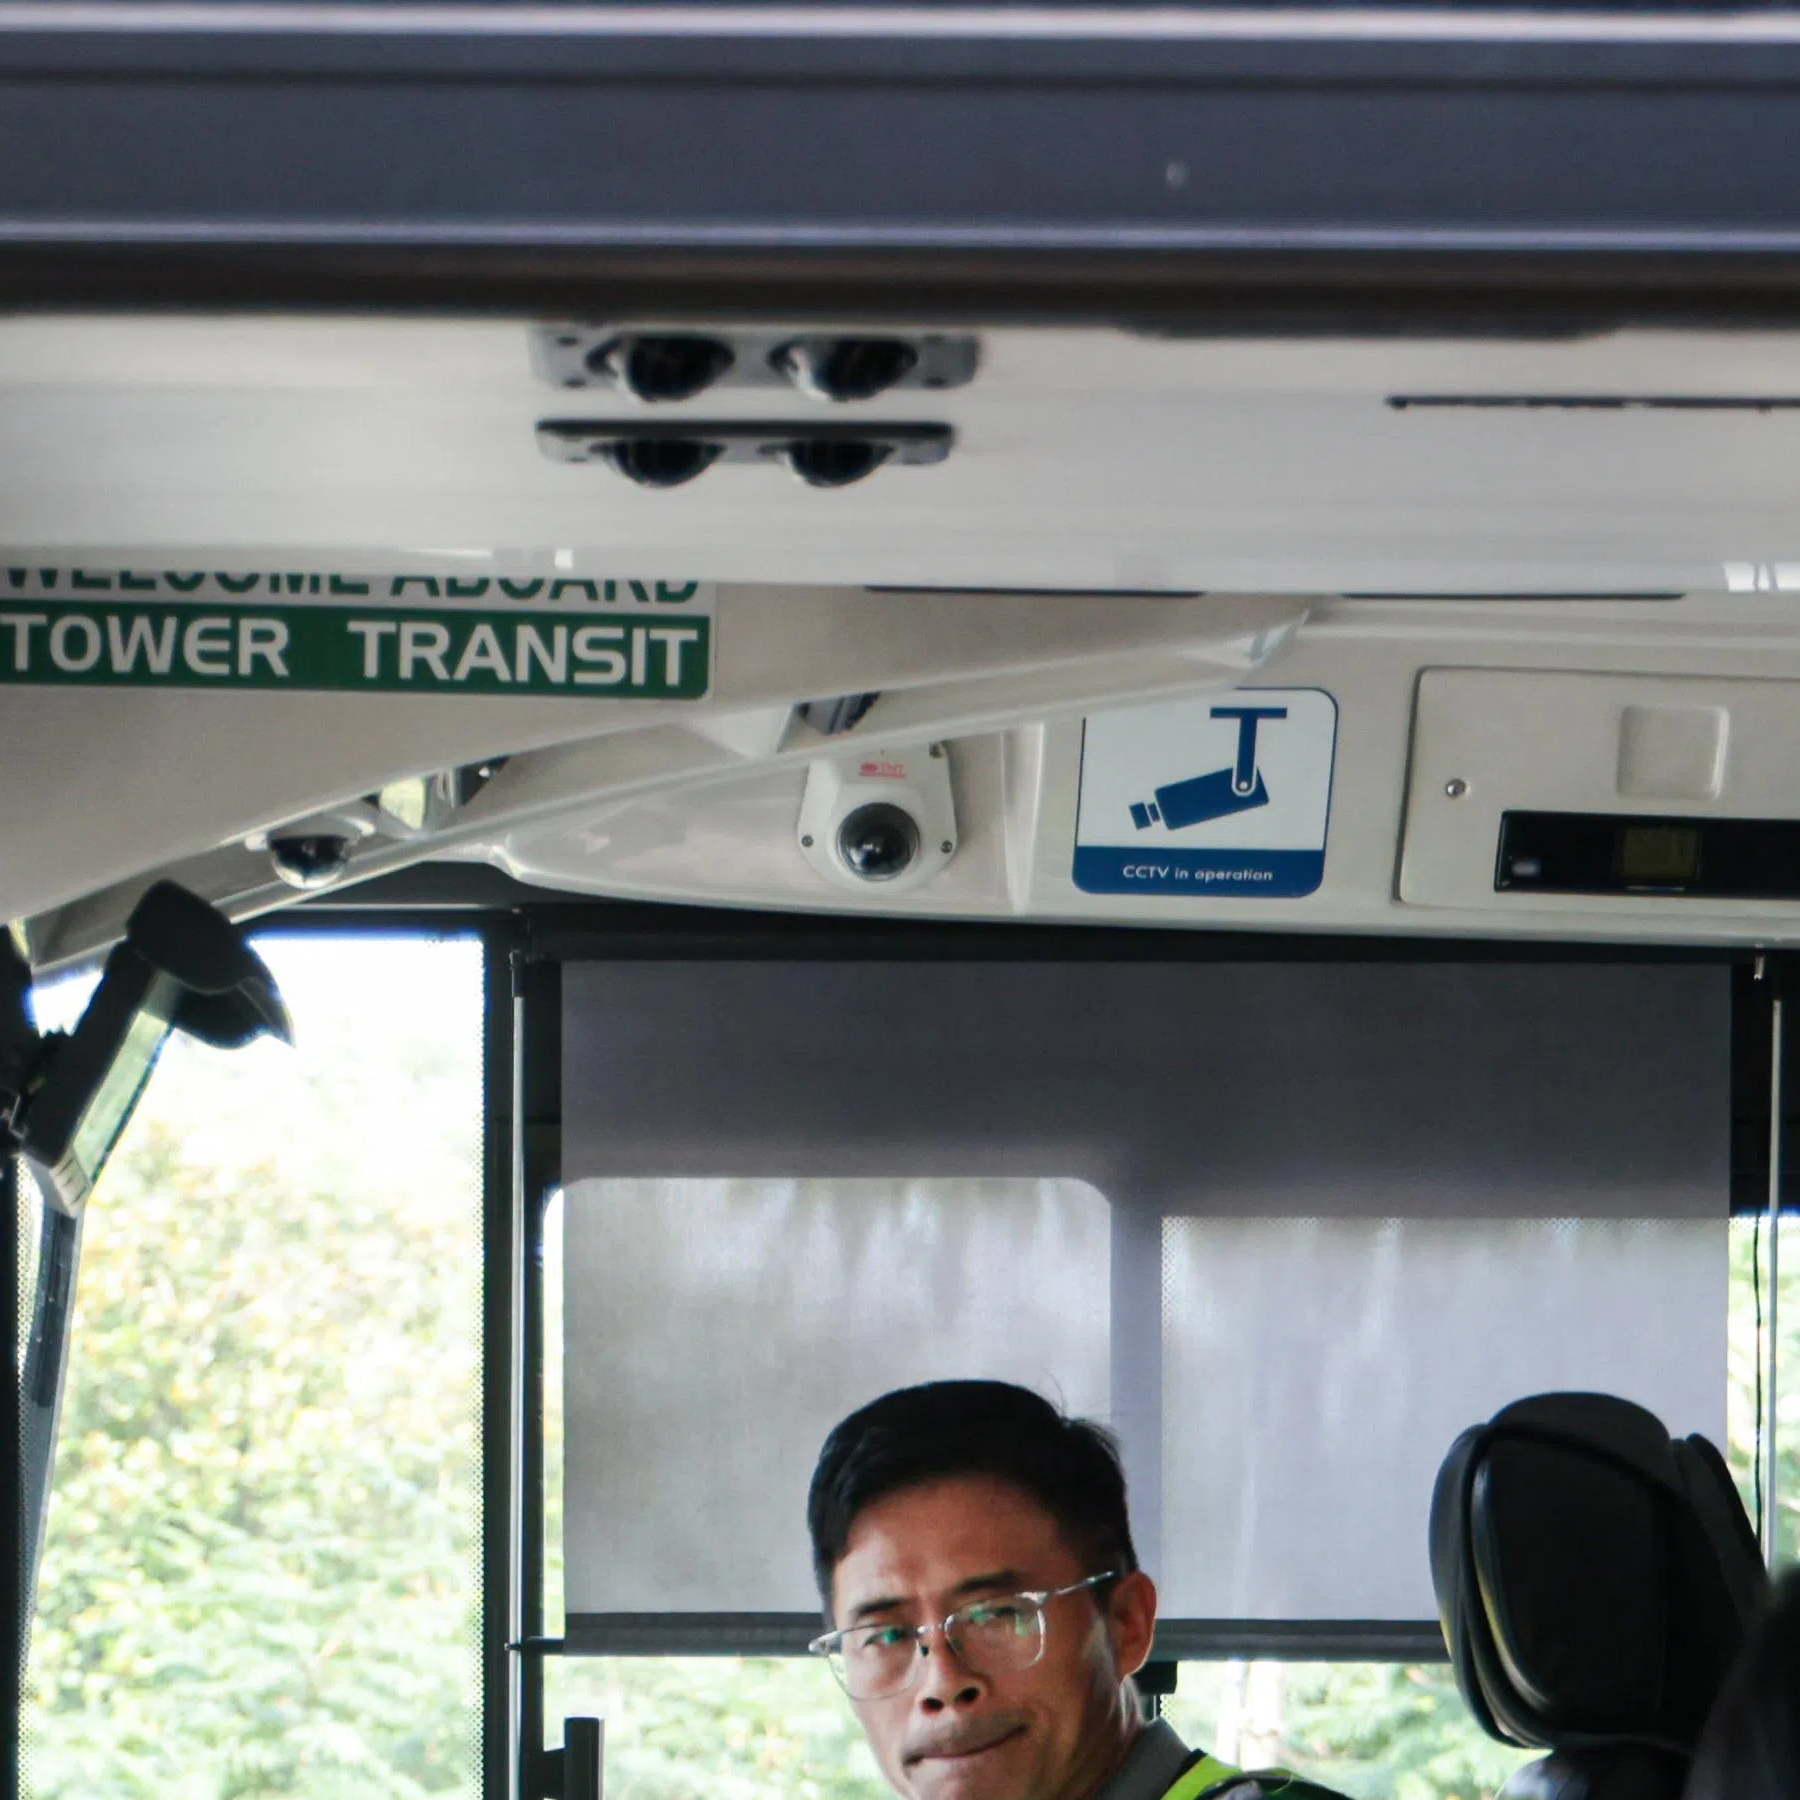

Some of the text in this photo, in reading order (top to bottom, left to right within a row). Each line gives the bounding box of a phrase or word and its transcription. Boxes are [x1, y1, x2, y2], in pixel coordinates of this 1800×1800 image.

[347, 620, 698, 687] TRANSIT
[1123, 865, 1273, 883] CCTV in operation
